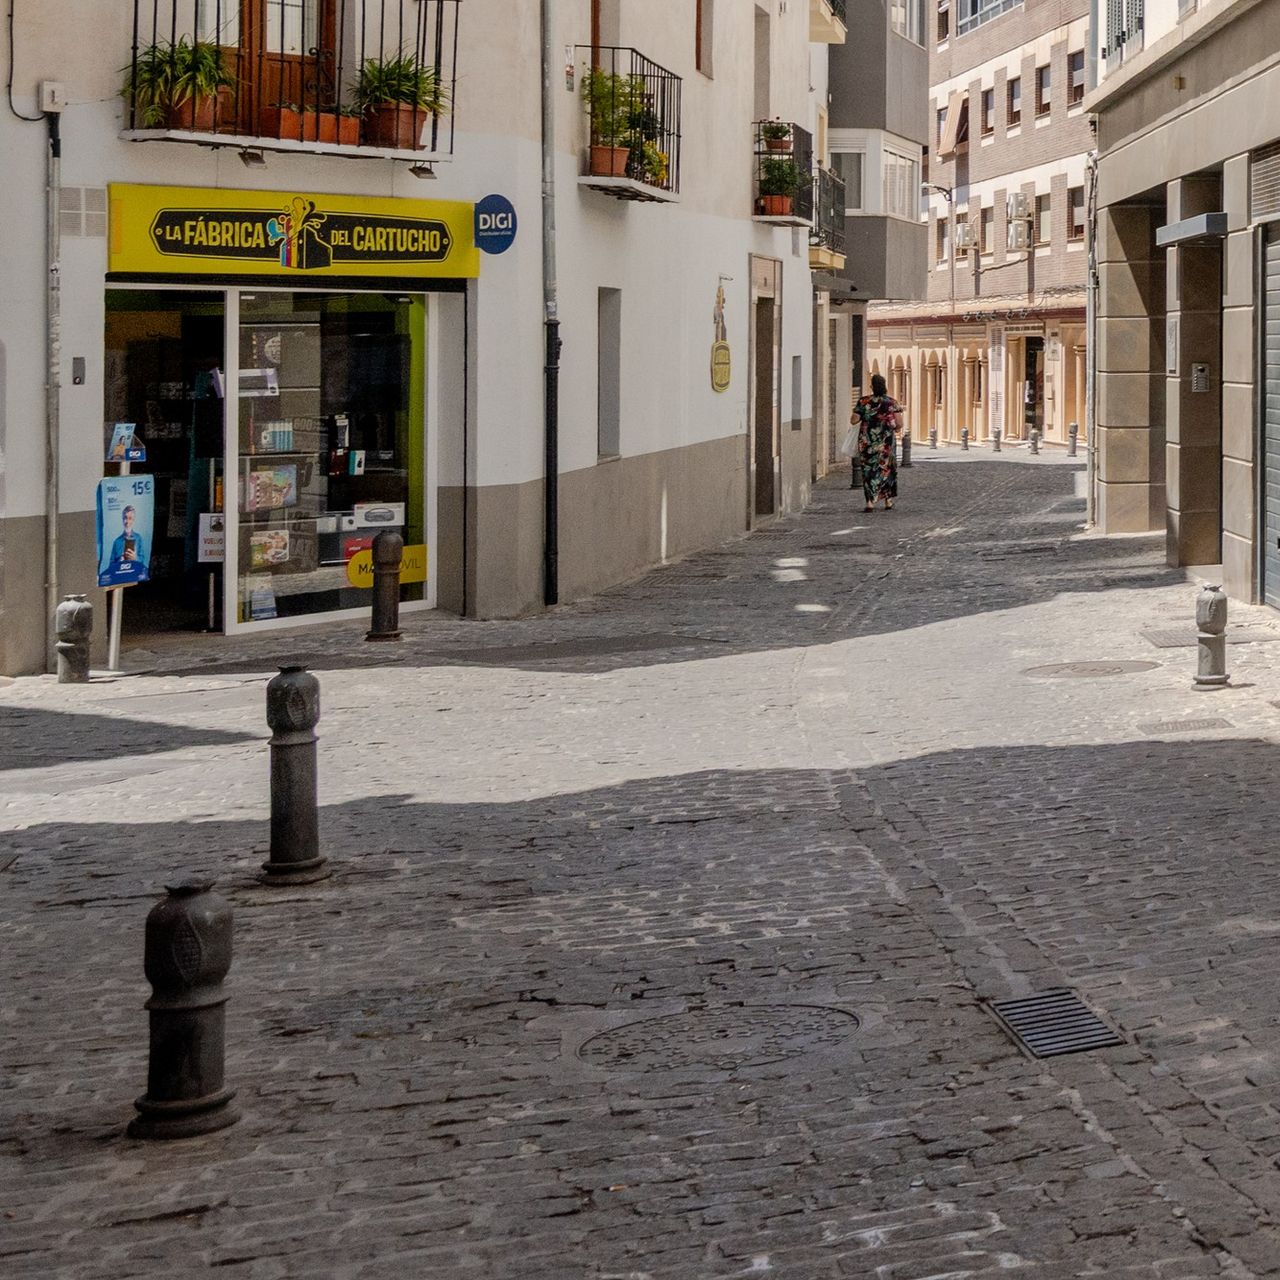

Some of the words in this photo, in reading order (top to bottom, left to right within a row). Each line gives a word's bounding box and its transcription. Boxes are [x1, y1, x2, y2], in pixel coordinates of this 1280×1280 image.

[479, 212, 512, 229] DIGI
[166, 225, 181, 240] LA
[184, 216, 265, 248] FÁBRICA
[331, 229, 351, 246] DEL
[353, 226, 440, 252] CARTUCHO
[132, 480, 152, 496] 15€
